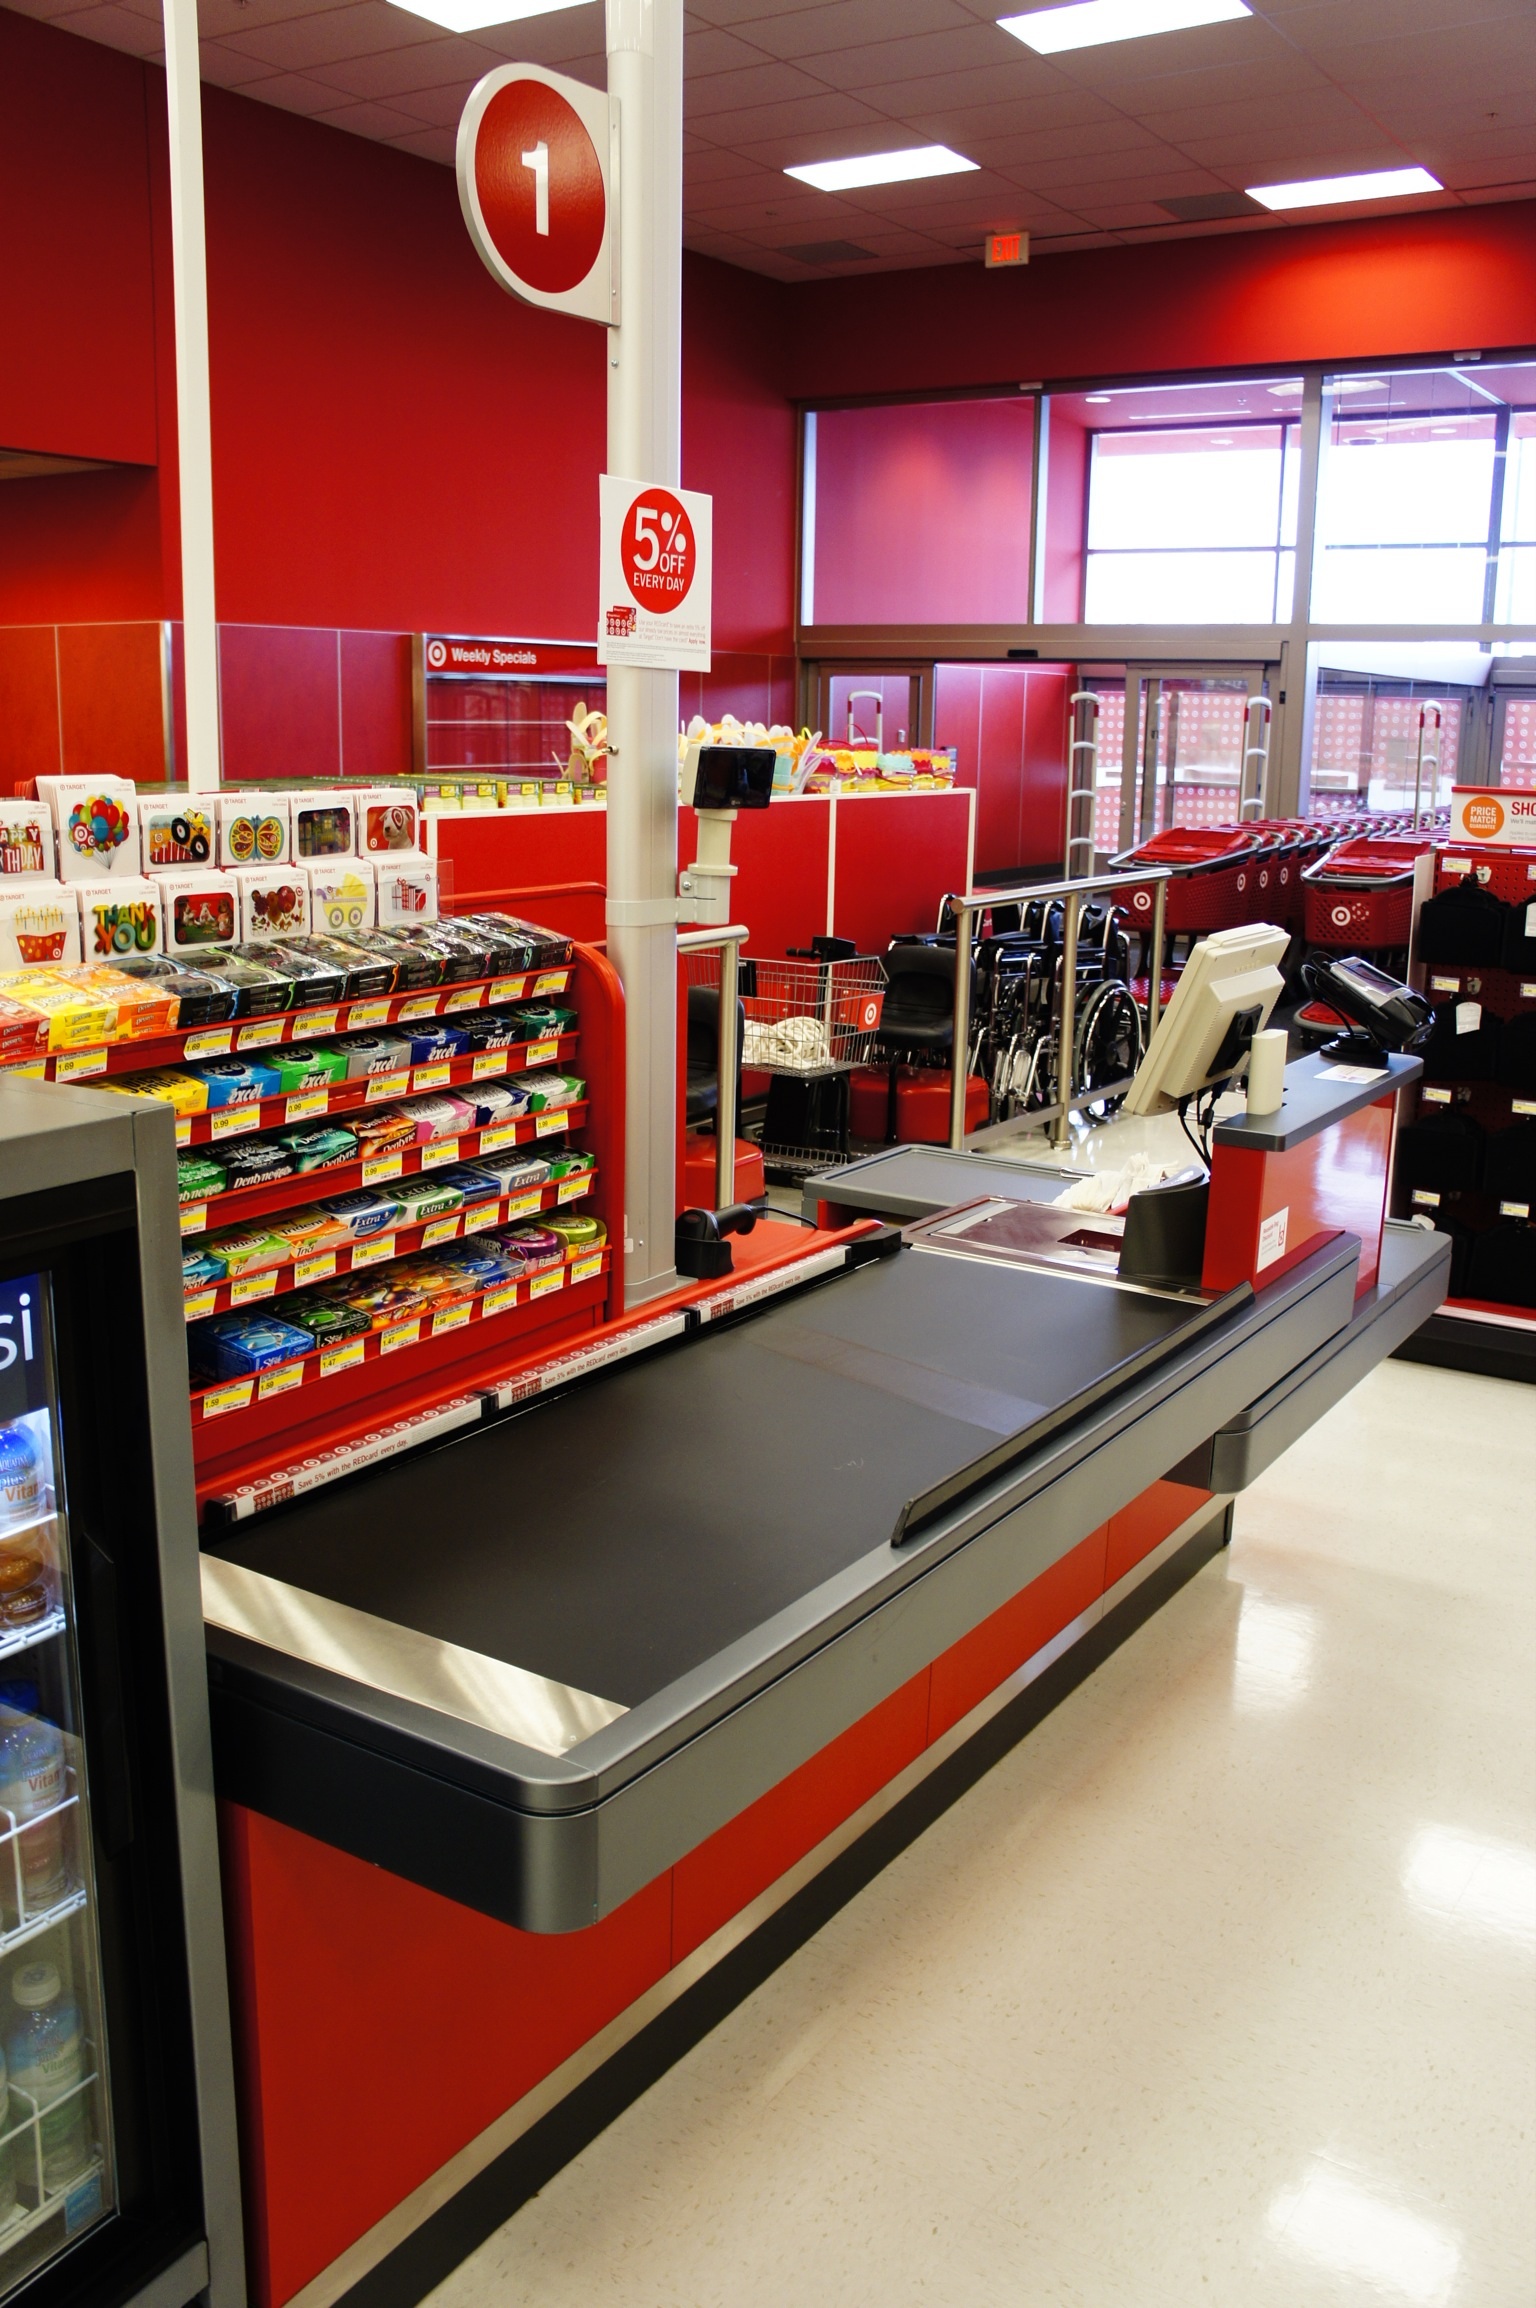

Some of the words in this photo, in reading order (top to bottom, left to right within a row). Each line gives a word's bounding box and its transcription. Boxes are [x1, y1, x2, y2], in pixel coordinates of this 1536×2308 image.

[521, 140, 549, 236] 1
[633, 506, 687, 571] 5%
[660, 553, 686, 575] OFF
[634, 572, 664, 591] EVERY
[666, 576, 685, 592] DAY
[451, 648, 491, 665] Weekly
[492, 650, 537, 666] Specials
[1470, 806, 1496, 816] PRICE
[1470, 816, 1496, 824] MATCH
[92, 902, 156, 930] THANK
[94, 919, 157, 955] YOU
[240, 1033, 253, 1041] 1.69
[538, 1022, 564, 1040] excel
[186, 1043, 200, 1052] 1.69
[486, 1032, 514, 1050] excel
[428, 1044, 458, 1062] excel
[58, 1062, 74, 1072] 1.69
[368, 1055, 400, 1074] excel
[300, 1068, 334, 1090] excel
[227, 1082, 263, 1104] excel
[370, 1084, 383, 1092] 0.99
[288, 1104, 302, 1112] 0.99
[214, 1120, 229, 1130] 0.99
[384, 1132, 416, 1152] Dentyne
[424, 1152, 436, 1161] 0.99
[490, 1154, 526, 1168] Extra
[234, 1170, 273, 1189] Dentyne
[364, 1167, 377, 1176] 0.99
[515, 1172, 540, 1187] Extra
[396, 1182, 438, 1198] Extra
[329, 1193, 372, 1209] Extra
[420, 1202, 445, 1216] Extra
[281, 1219, 322, 1236] Trident
[355, 1214, 380, 1226] Extra
[221, 1236, 266, 1253] Trident
[297, 1267, 310, 1277] 1.59
[234, 1286, 248, 1296] 1.59
[383, 1337, 395, 1346] 1.47
[323, 1358, 336, 1368] 1.47
[544, 1376, 556, 1385] Save
[557, 1372, 565, 1381] 5%
[566, 1367, 576, 1376] with
[577, 1363, 585, 1372] the
[607, 1349, 619, 1360] every
[205, 1398, 219, 1409] 1.59
[298, 1478, 313, 1490] Save
[314, 1473, 325, 1482] 5%
[327, 1467, 340, 1479] with
[341, 1462, 351, 1473] the
[352, 1450, 378, 1468] REDcard
[380, 1445, 396, 1459] every
[396, 1439, 408, 1451] day.
